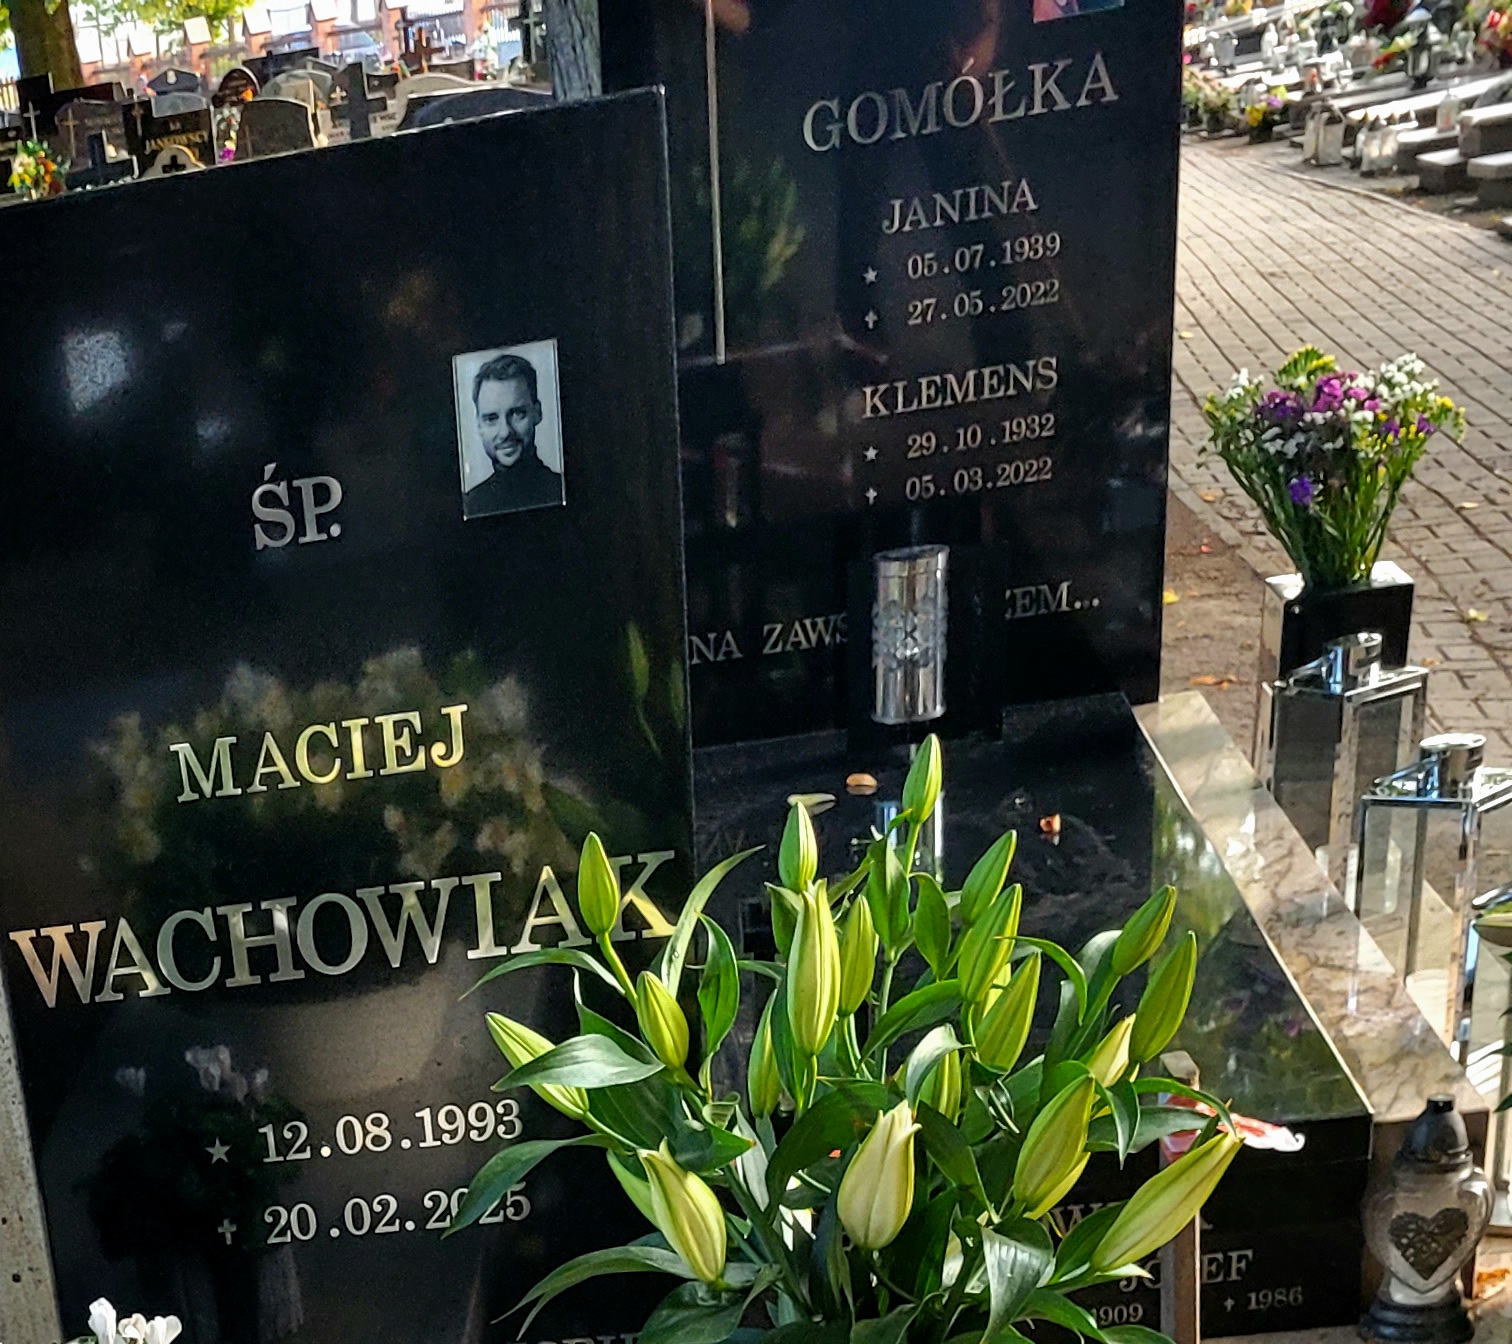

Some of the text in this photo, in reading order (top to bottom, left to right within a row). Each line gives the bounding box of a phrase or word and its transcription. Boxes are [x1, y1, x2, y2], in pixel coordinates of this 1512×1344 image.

[803, 53, 1120, 152] GOMÓŁKA
[882, 177, 1039, 235] JANINA
[906, 232, 1062, 280] 05.07.1939
[906, 279, 1061, 327] 27.05.2022
[862, 356, 1059, 420] KLEMENS
[906, 413, 1056, 460] 29.10.1932
[251, 462, 343, 551] ŚP.
[904, 457, 1053, 502] 05.03.2022
[689, 630, 744, 666] NA
[170, 703, 469, 804] MACIEJ
[9, 850, 680, 1009] WACHOWIAK
[258, 1098, 524, 1164] 12.08.1993
[1246, 1286, 1304, 1312] 1986
